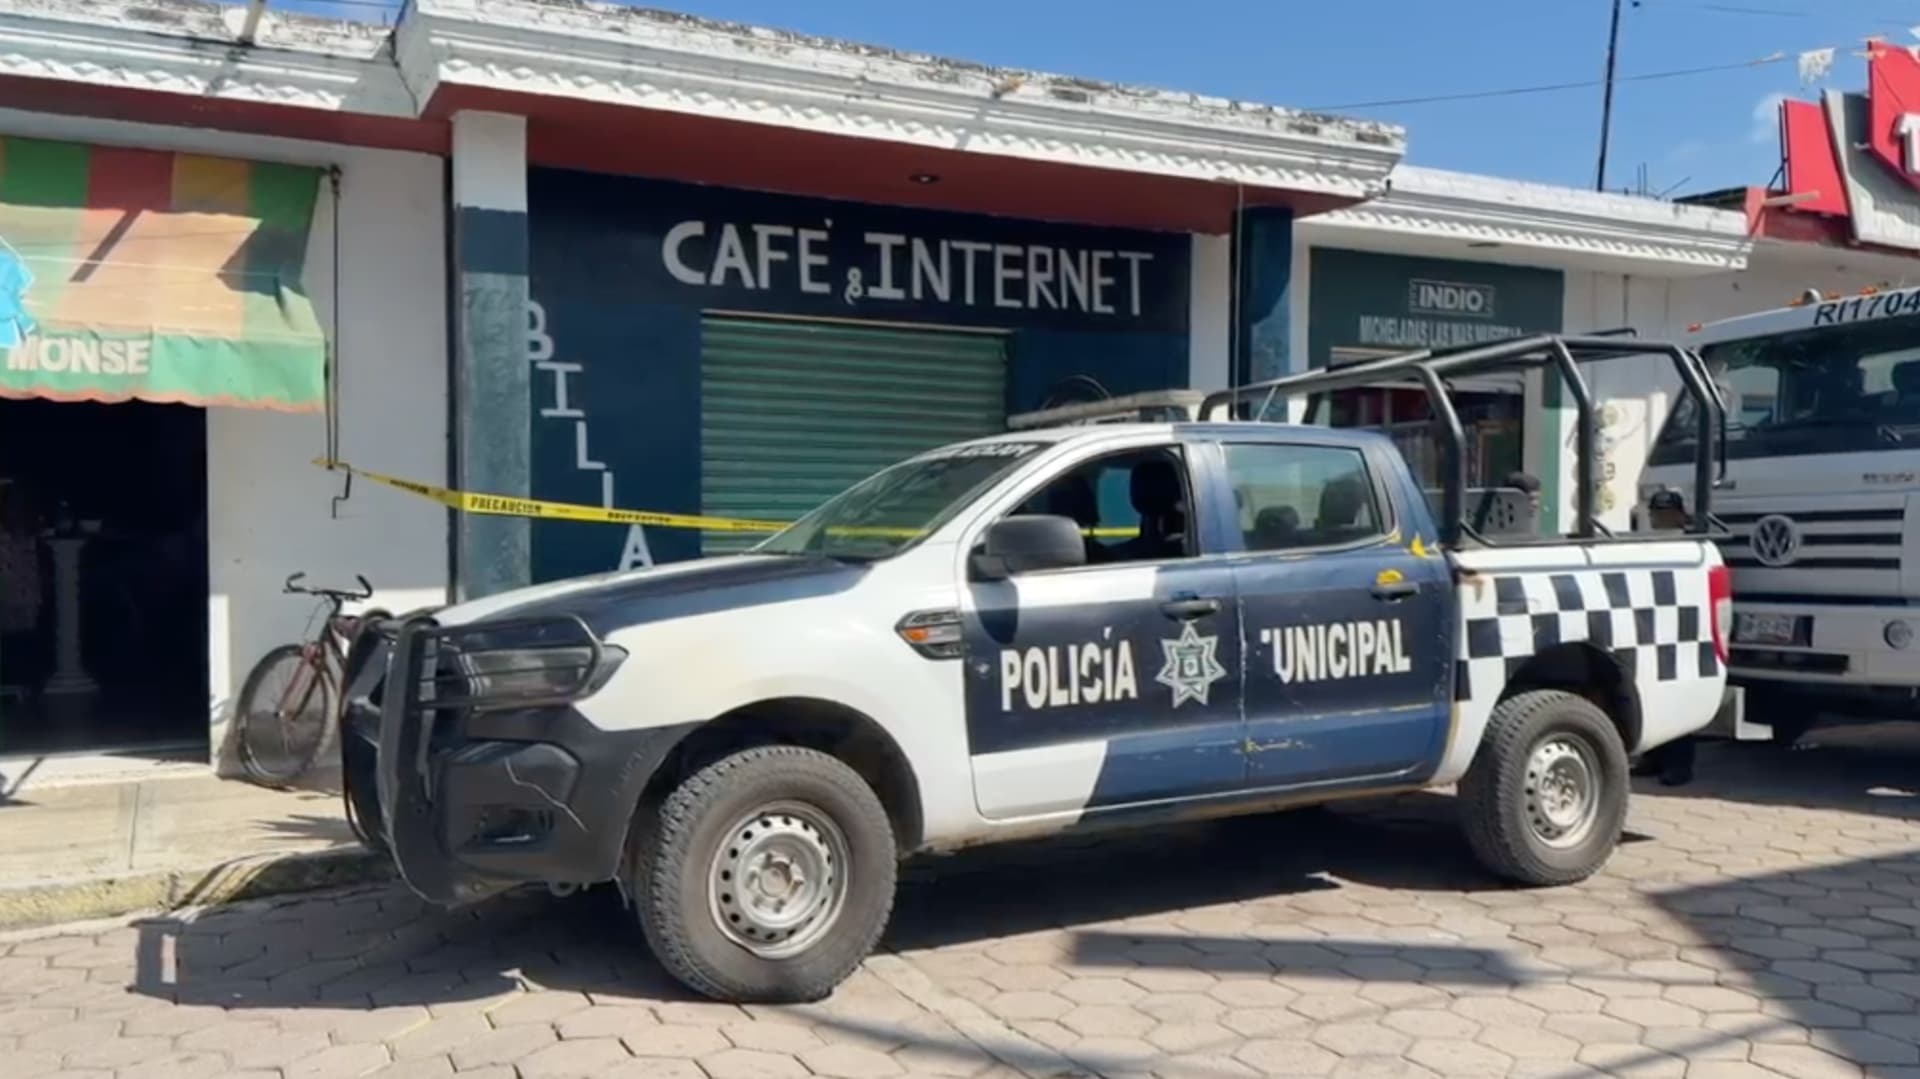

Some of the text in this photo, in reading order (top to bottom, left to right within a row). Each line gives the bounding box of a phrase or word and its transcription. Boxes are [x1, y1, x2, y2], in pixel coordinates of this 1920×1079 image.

[865, 232, 1153, 316] INTERNET
[1419, 285, 1483, 311] INDIO
[7, 335, 151, 375] MONSE
[1260, 619, 1411, 684] UNICIPAL
